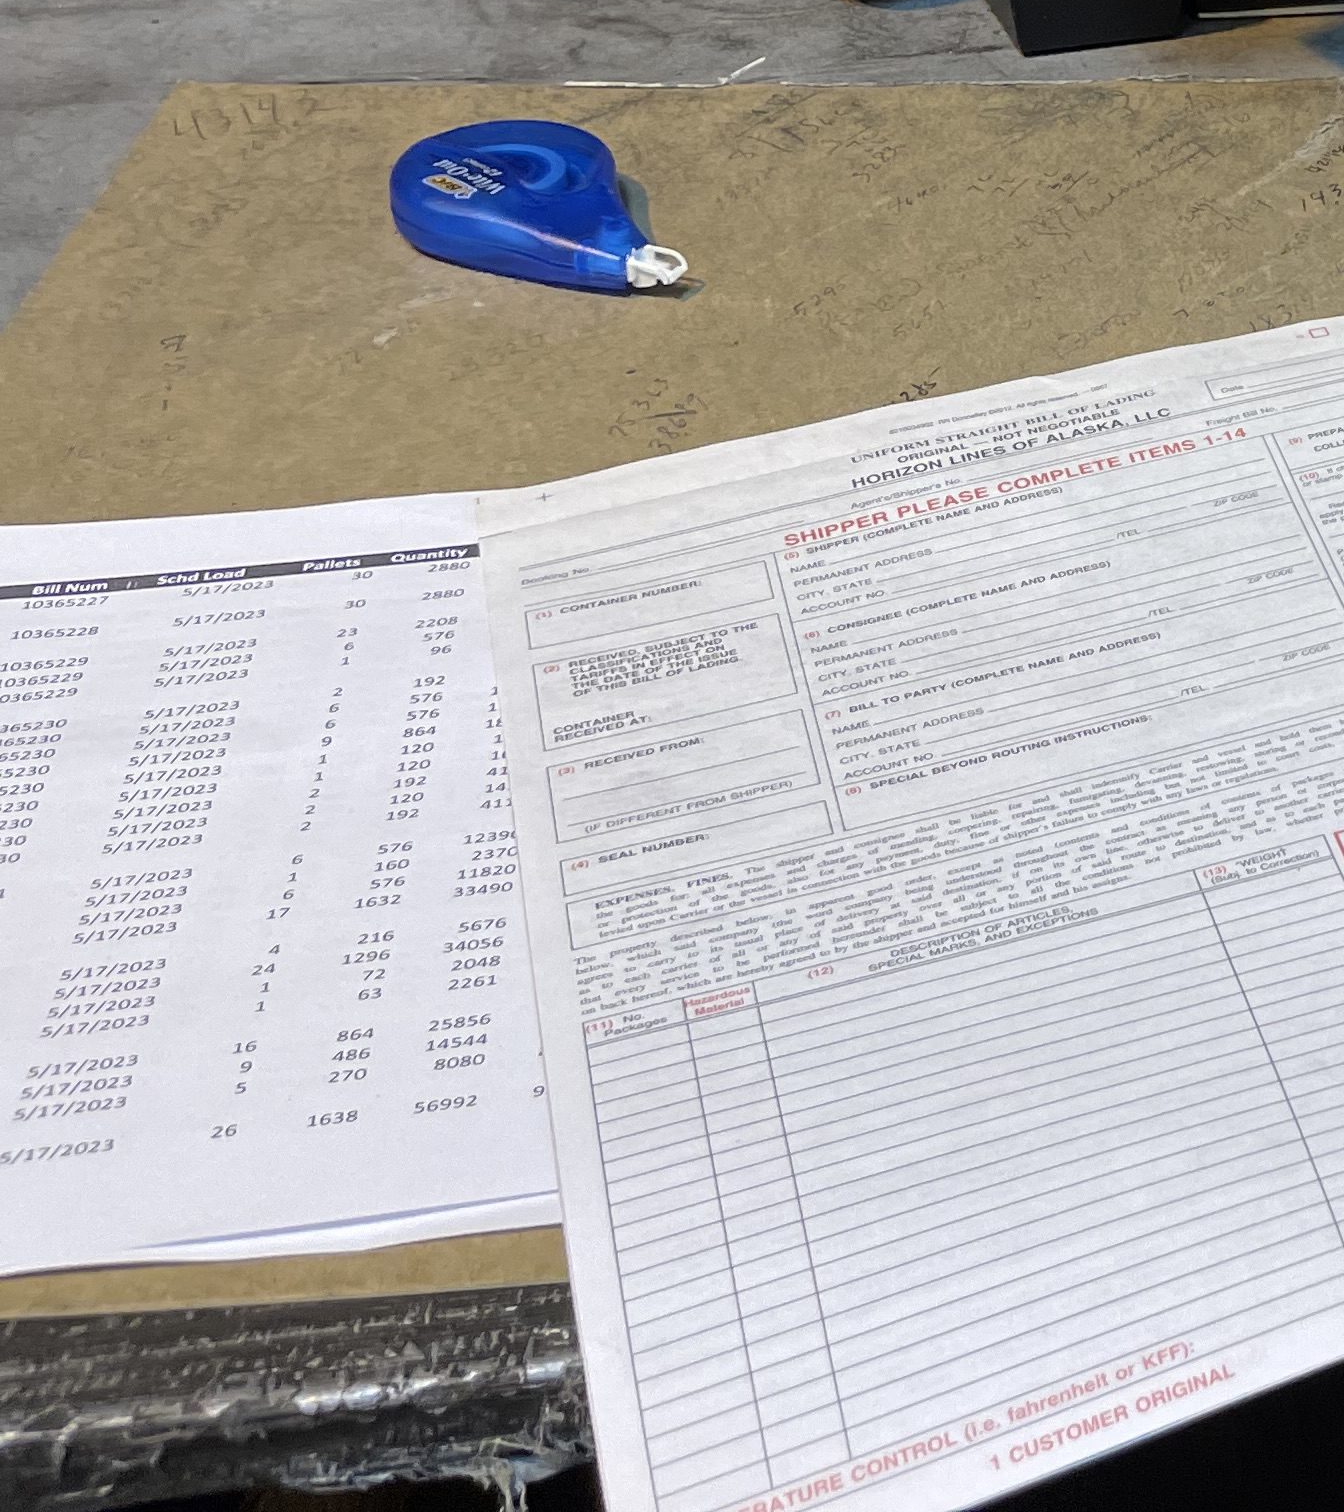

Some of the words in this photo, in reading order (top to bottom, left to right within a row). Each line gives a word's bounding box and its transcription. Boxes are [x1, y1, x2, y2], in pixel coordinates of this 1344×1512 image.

[850, 439, 931, 464] UNIFORM
[934, 421, 1018, 444] STRAIGHT
[1025, 411, 1059, 426] BILL
[1066, 404, 1091, 417] OF
[1094, 388, 1156, 411] LADING
[897, 443, 969, 463] ORIGINAL
[993, 430, 1023, 443] NOT
[1027, 409, 1121, 435] NEGOTIABLE
[851, 459, 944, 488] HORIZON
[949, 445, 1007, 465] LINES
[1012, 436, 1040, 451] OF
[1045, 418, 1131, 444] ALASKA,
[1133, 407, 1171, 425] LLC
[784, 511, 889, 548] SHIPPER
[896, 485, 989, 519] PLEASE
[996, 455, 1121, 495] COMPLETE
[1127, 438, 1197, 464] ITEMS
[1205, 427, 1248, 447] 1-14
[302, 558, 362, 572] Pallets
[390, 546, 470, 564] Quantity
[22, 595, 110, 610] 10365227
[182, 579, 275, 597] 5/17/2023
[352, 570, 374, 581] 30
[427, 561, 471, 573] 2880
[157, 572, 200, 587] Schd
[203, 568, 247, 582] Load
[31, 583, 61, 597] Bill
[64, 581, 109, 594] Num
[559, 593, 638, 614] CONTAINER
[10, 626, 100, 641] 10365228
[583, 748, 655, 769] RECEIVED
[598, 849, 638, 864] SEAL
[457, 863, 517, 881] 11820
[452, 881, 514, 898] 33490
[427, 1013, 493, 1033] 25856
[424, 1033, 489, 1052] 14544
[306, 1110, 359, 1128] 1638
[412, 1094, 478, 1115] 56992
[850, 1430, 959, 1484] CONTROL
[1005, 1372, 1110, 1424] fahrenheit
[1114, 1363, 1135, 1381] or
[988, 1455, 1001, 1470] 1
[1009, 1404, 1130, 1466] CUSTOMER
[1134, 1363, 1236, 1414] ORIGINAL
